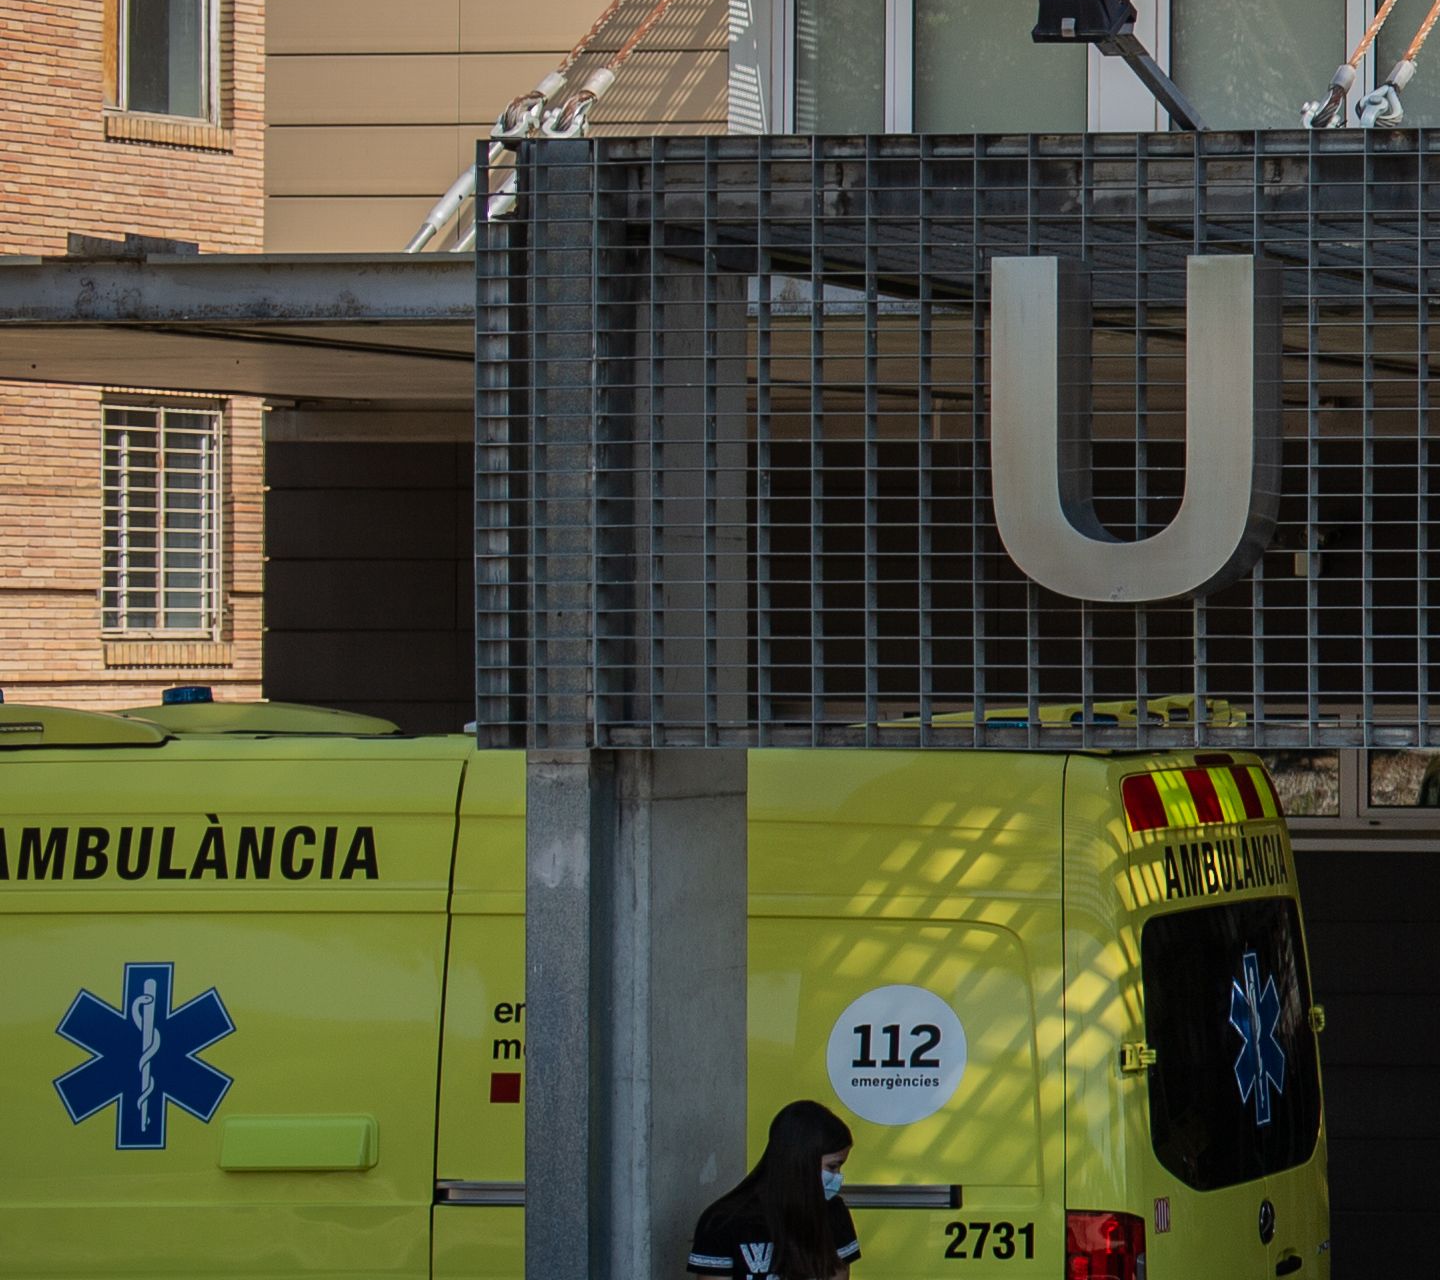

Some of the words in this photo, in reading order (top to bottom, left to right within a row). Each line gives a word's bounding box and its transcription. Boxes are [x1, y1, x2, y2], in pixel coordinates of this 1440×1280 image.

[0, 814, 380, 881] MBULÀNCIA
[1163, 825, 1289, 900] AMBULÀNCIA
[851, 1024, 942, 1069] 112
[851, 1073, 940, 1090] emergències
[944, 1221, 1035, 1260] 2731
